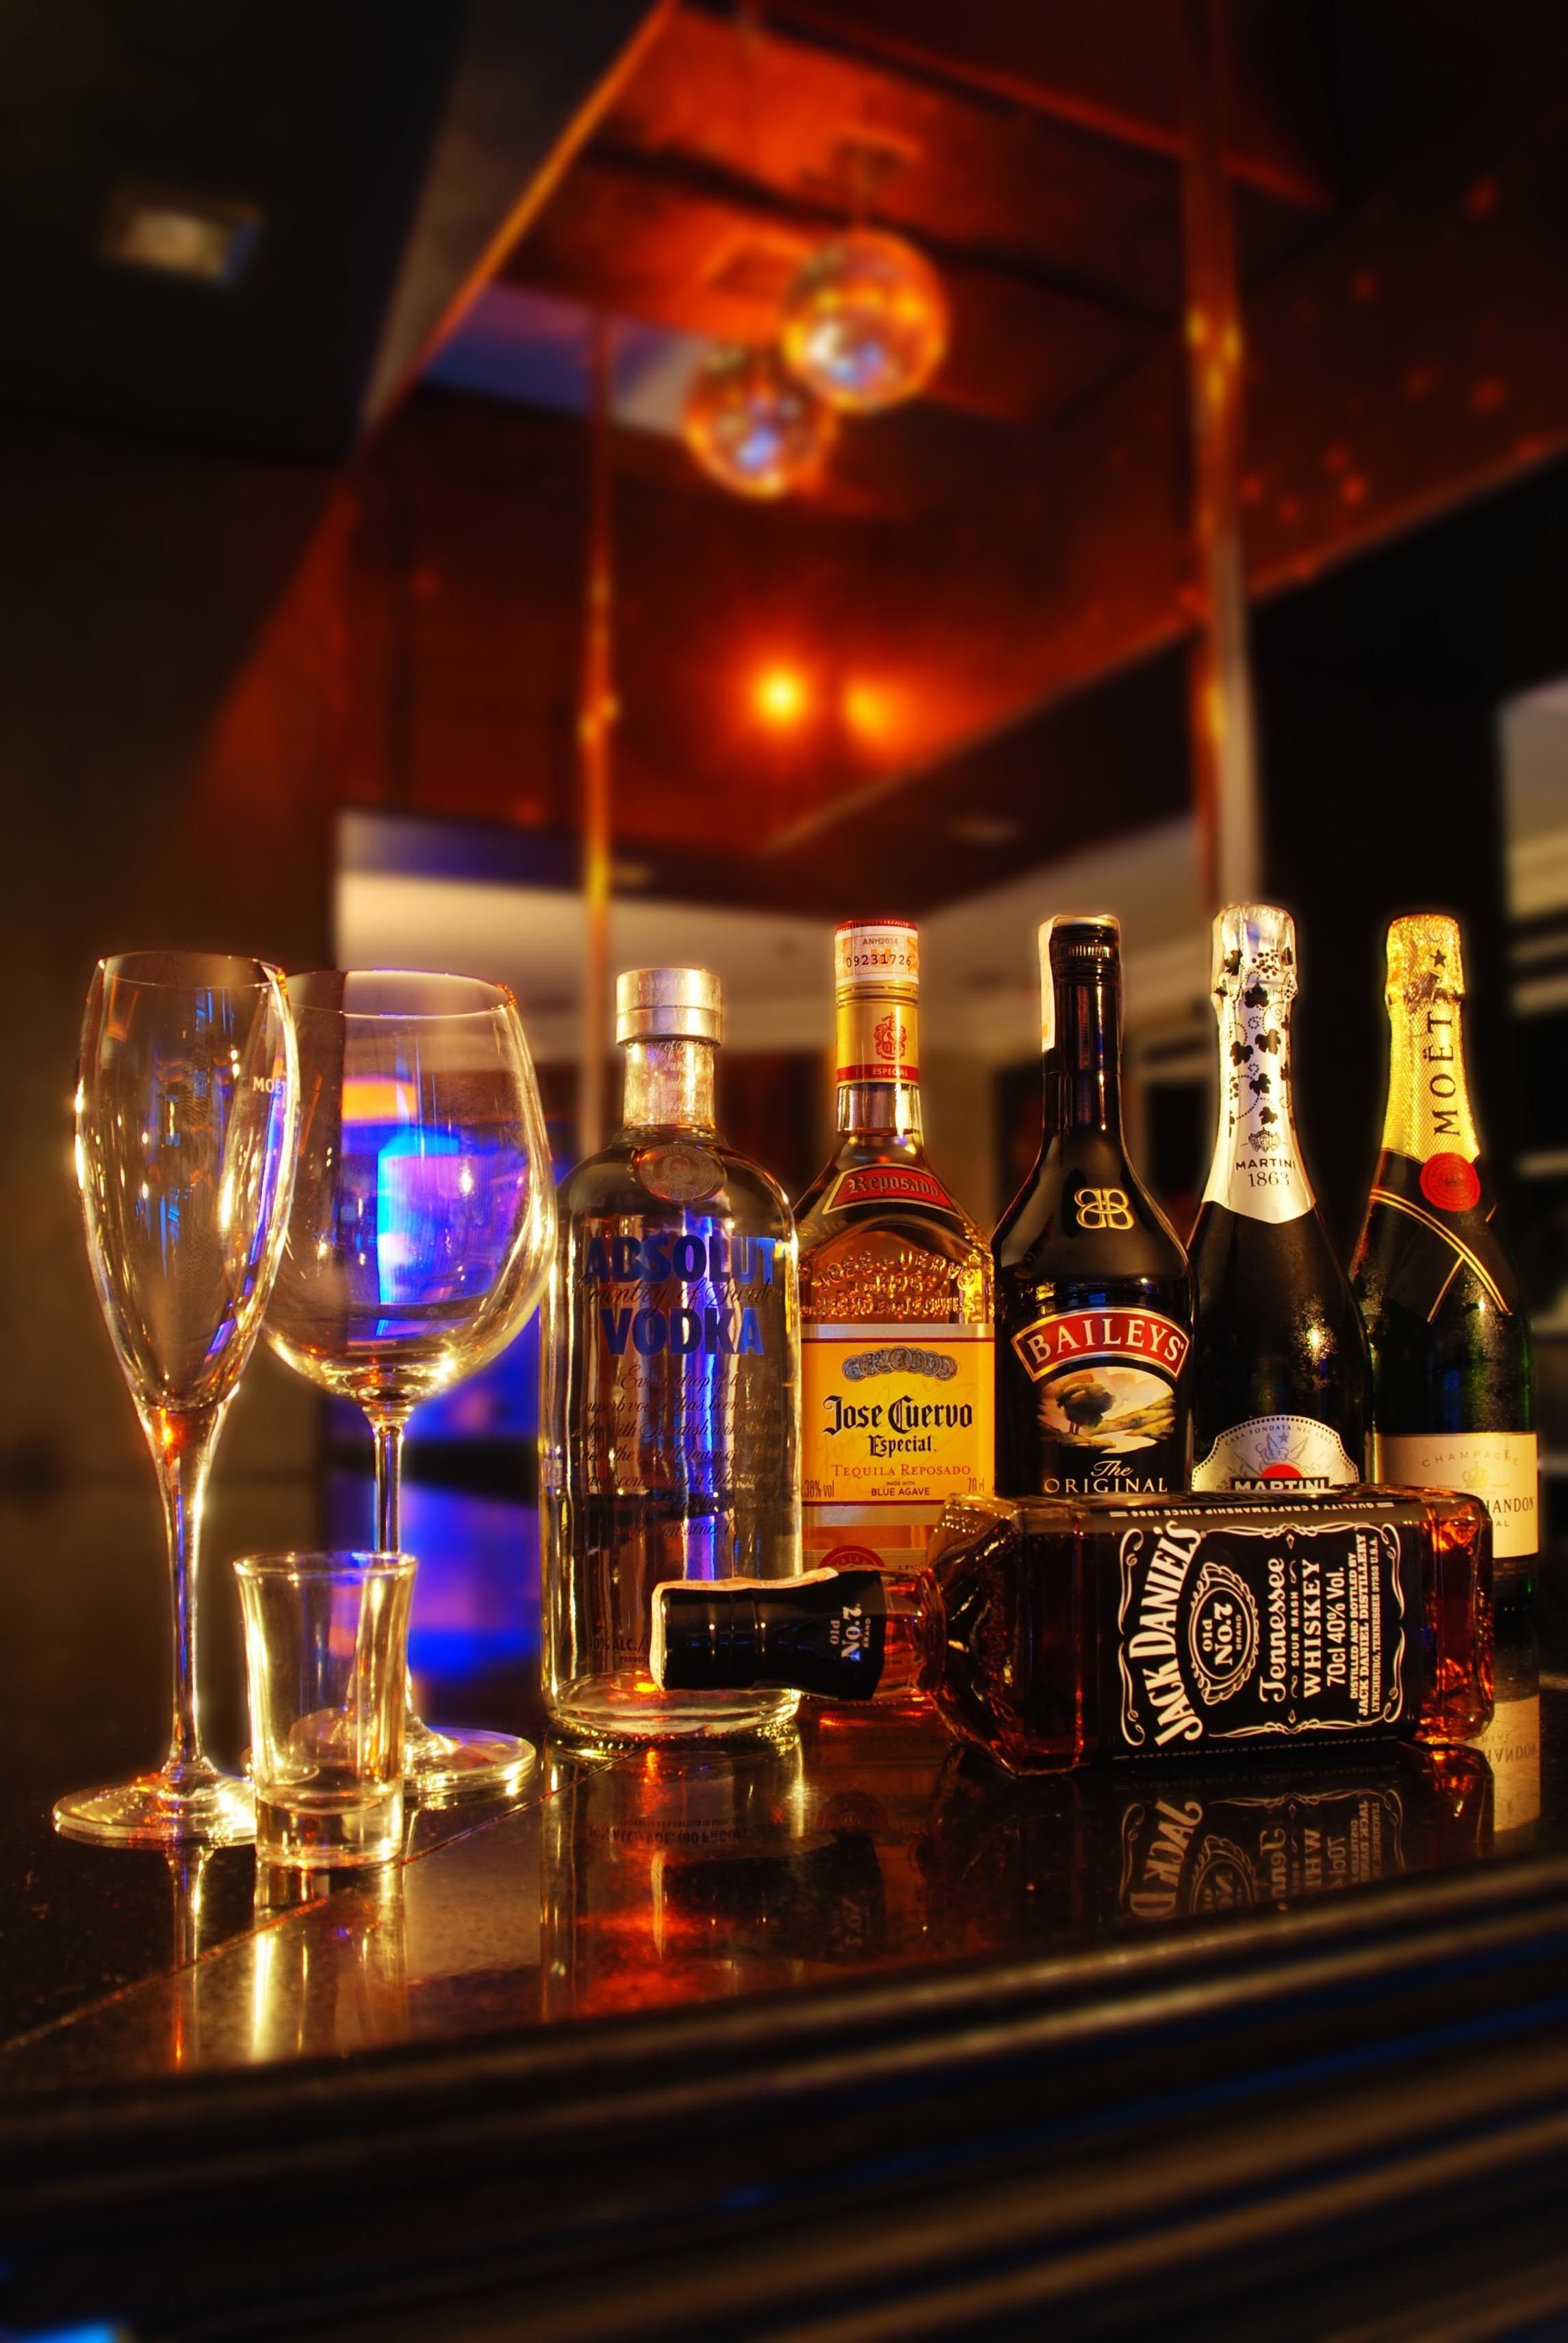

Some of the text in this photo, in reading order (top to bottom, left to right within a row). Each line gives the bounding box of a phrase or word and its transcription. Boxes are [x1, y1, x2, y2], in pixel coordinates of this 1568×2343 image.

[846, 954, 912, 968] 09231726
[873, 1068, 909, 1077] ESPECAL
[1424, 1011, 1460, 1136] MOËT
[1236, 1159, 1296, 1170] MARTINI
[848, 1175, 940, 1196] Reposado
[1248, 1172, 1290, 1187] 1863
[585, 1235, 776, 1285] ABSOLUT
[678, 1277, 708, 1318] of
[601, 1307, 764, 1355] VODKA
[1027, 1318, 1183, 1364] BAILEYS
[823, 1394, 884, 1436] Jose
[888, 1394, 973, 1435] Cuervo
[1249, 1424, 1292, 1435] FONDATA
[831, 1463, 971, 1478] TEQUILA REPOSADO
[1090, 1460, 1133, 1478] The
[823, 1479, 835, 1498] vol
[871, 1487, 931, 1496] BLUE AGAVE
[1044, 1478, 1168, 1494] ORIGINAL
[1163, 1508, 1202, 1517] SINCE
[1205, 1505, 1309, 1515] CRAFTSMANSHIP
[1322, 1502, 1374, 1511] QUALITY
[829, 1619, 841, 1645] Old
[863, 1618, 872, 1649] BRAND
[1203, 1619, 1213, 1652] Old
[1259, 1557, 1287, 1702] Tennessee
[1291, 1591, 1300, 1667] SOUR MASH
[1302, 1559, 1323, 1699] WHISKEY
[1325, 1566, 1346, 1687] 70cl 40% Vol.
[1348, 1552, 1359, 1699] DISTILLED AND BOTTLED BY
[1356, 1533, 1370, 1716] JACK DANIEL DISTILLERY
[1142, 1657, 1203, 1747] JACK
